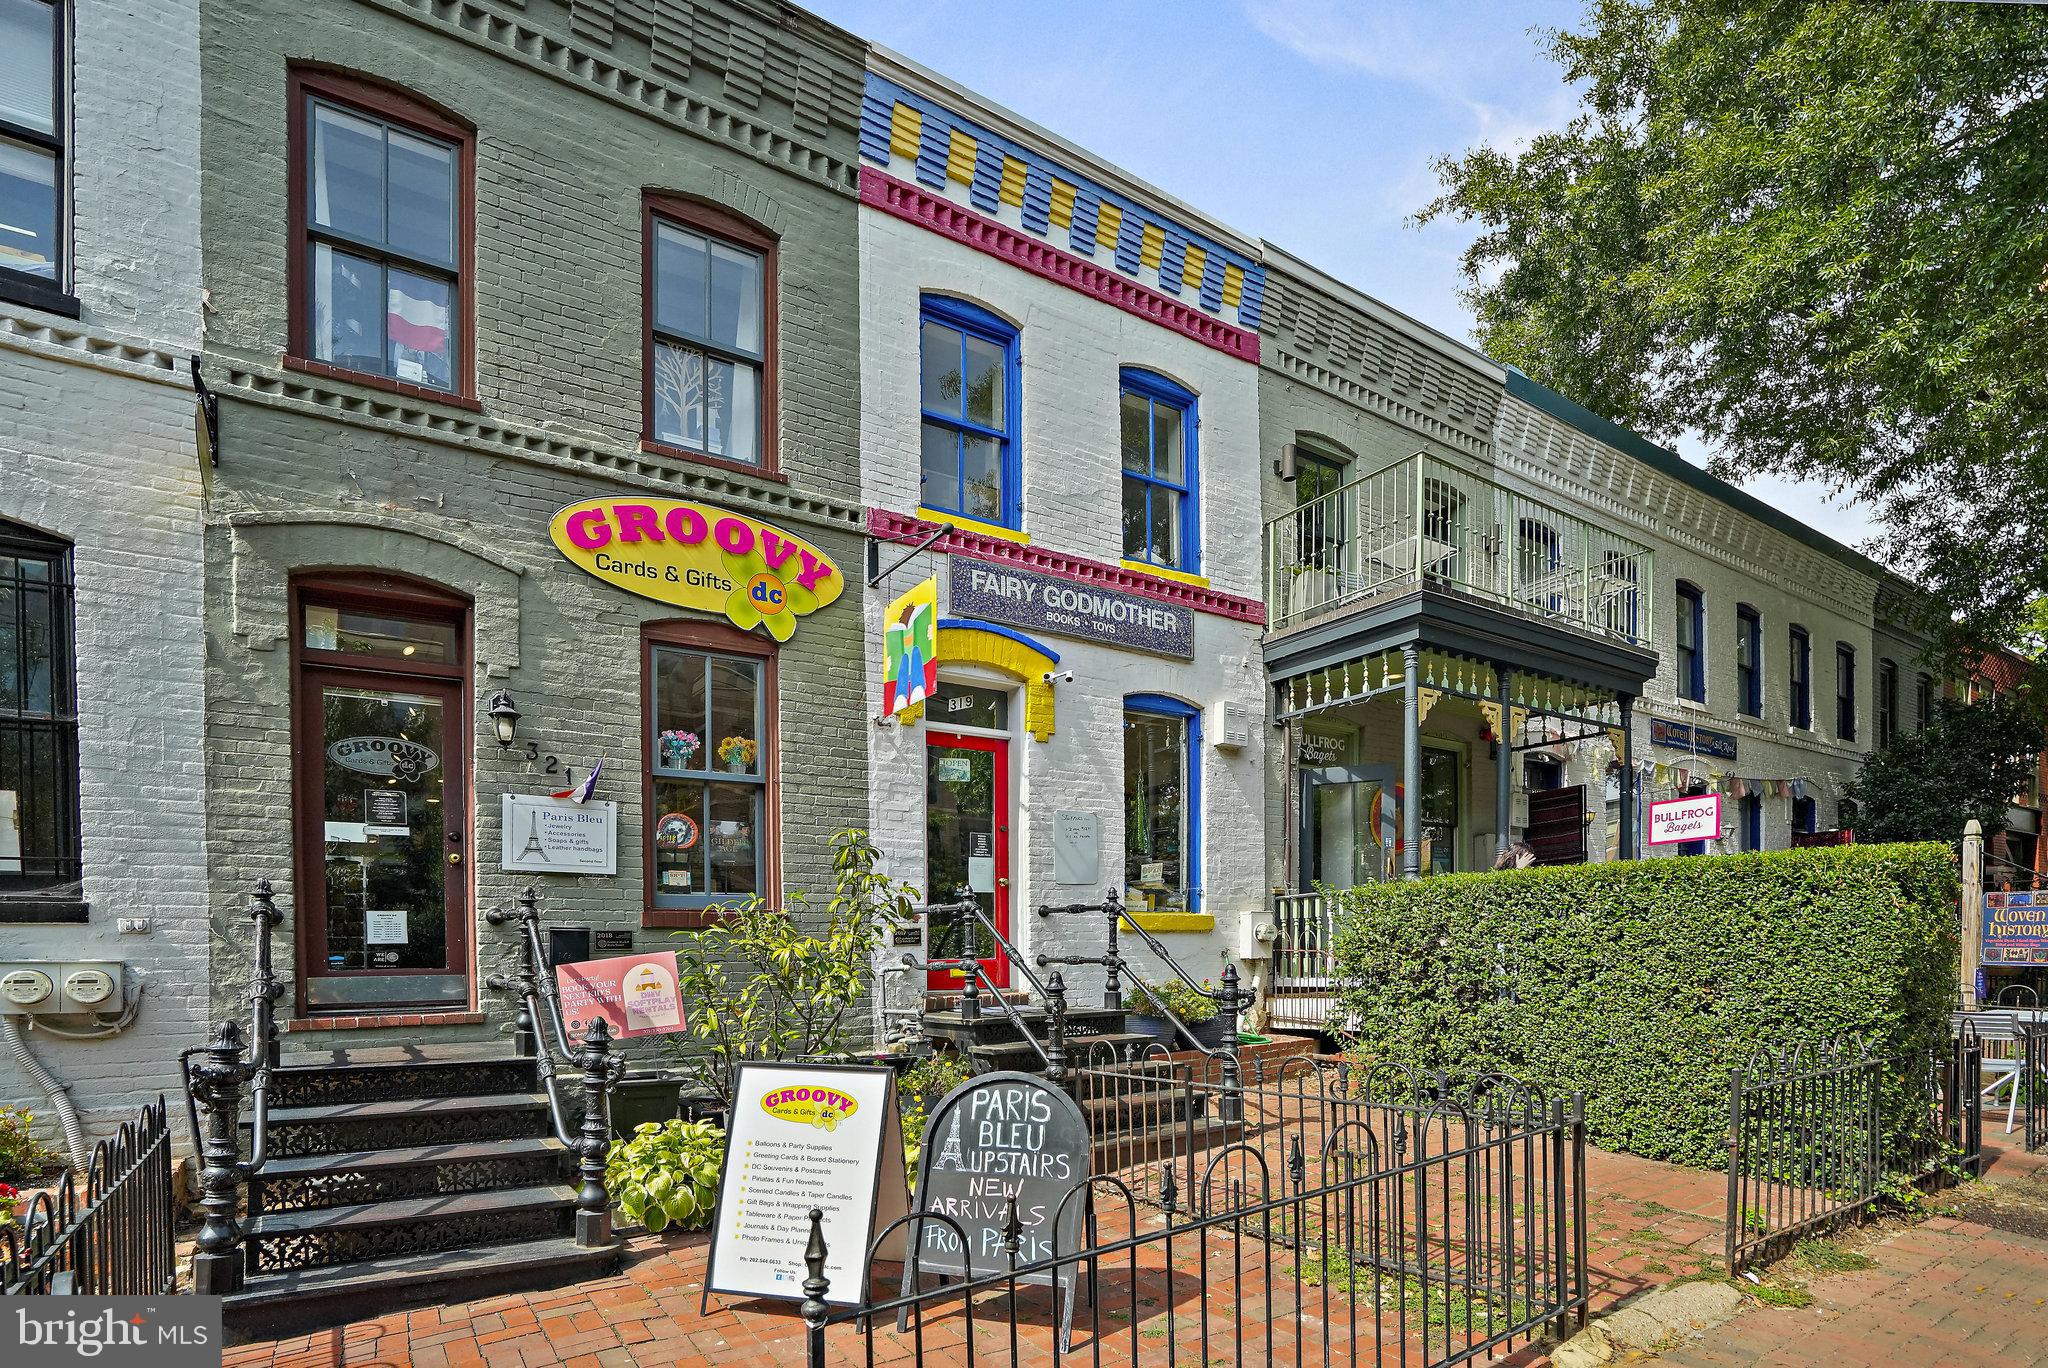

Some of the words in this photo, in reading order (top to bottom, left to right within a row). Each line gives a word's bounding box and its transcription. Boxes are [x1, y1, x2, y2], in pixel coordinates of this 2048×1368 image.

[566, 505, 832, 592] GROOVY
[595, 553, 658, 579] Cards
[665, 567, 680, 582] &
[686, 569, 732, 592] Gifts
[751, 581, 783, 604] dc
[971, 570, 1037, 602] FAIRY
[1043, 585, 1179, 633] GODMOTHER
[1046, 612, 1080, 627] BOOKS
[1092, 620, 1116, 634] TOYS
[951, 697, 972, 709] 319
[1301, 734, 1345, 751] ULLFROG
[337, 740, 433, 761] GROOVY
[1303, 745, 1338, 763] Bagels
[402, 761, 414, 769] dc
[543, 811, 573, 821] Paris
[577, 814, 603, 824] Bleu
[1654, 807, 1713, 823] BULLFROG
[1664, 820, 1702, 834] Bagels
[562, 984, 587, 993] BOOK
[590, 980, 616, 990] YOUR
[563, 991, 586, 1000] NEXT
[564, 998, 594, 1008] PARTY
[597, 994, 622, 1003] WITH
[765, 1088, 853, 1112] GROOVY
[971, 1084, 1051, 1123] PARIS
[772, 1107, 792, 1115] Cards
[822, 1110, 833, 1118] dc
[979, 1121, 1045, 1151] BLEU
[755, 1140, 781, 1148] Balloons
[806, 1144, 833, 1152] Supplies
[753, 1152, 779, 1160] Greeting
[828, 1156, 860, 1166] Stationery
[971, 1150, 1071, 1180] UPSTAIRS
[763, 1164, 793, 1172] Souvenirs
[801, 1167, 832, 1175] Postcards
[752, 1175, 775, 1183] Pinatas
[796, 1178, 824, 1186] Novelties
[969, 1177, 1025, 1198] NEW
[748, 1186, 773, 1194] Scented
[774, 1189, 800, 1197] Candles
[808, 1191, 825, 1199] Taper
[826, 1192, 853, 1200] Candles
[759, 1200, 775, 1208] Bags
[782, 1202, 812, 1211] Wrapping
[813, 1203, 840, 1212] Supplies
[745, 1210, 776, 1219] Tableware
[784, 1213, 801, 1222] Paper
[744, 1222, 769, 1231] Journals
[777, 1225, 790, 1233] Day
[742, 1234, 760, 1242] Photo
[761, 1235, 785, 1243] Frames
